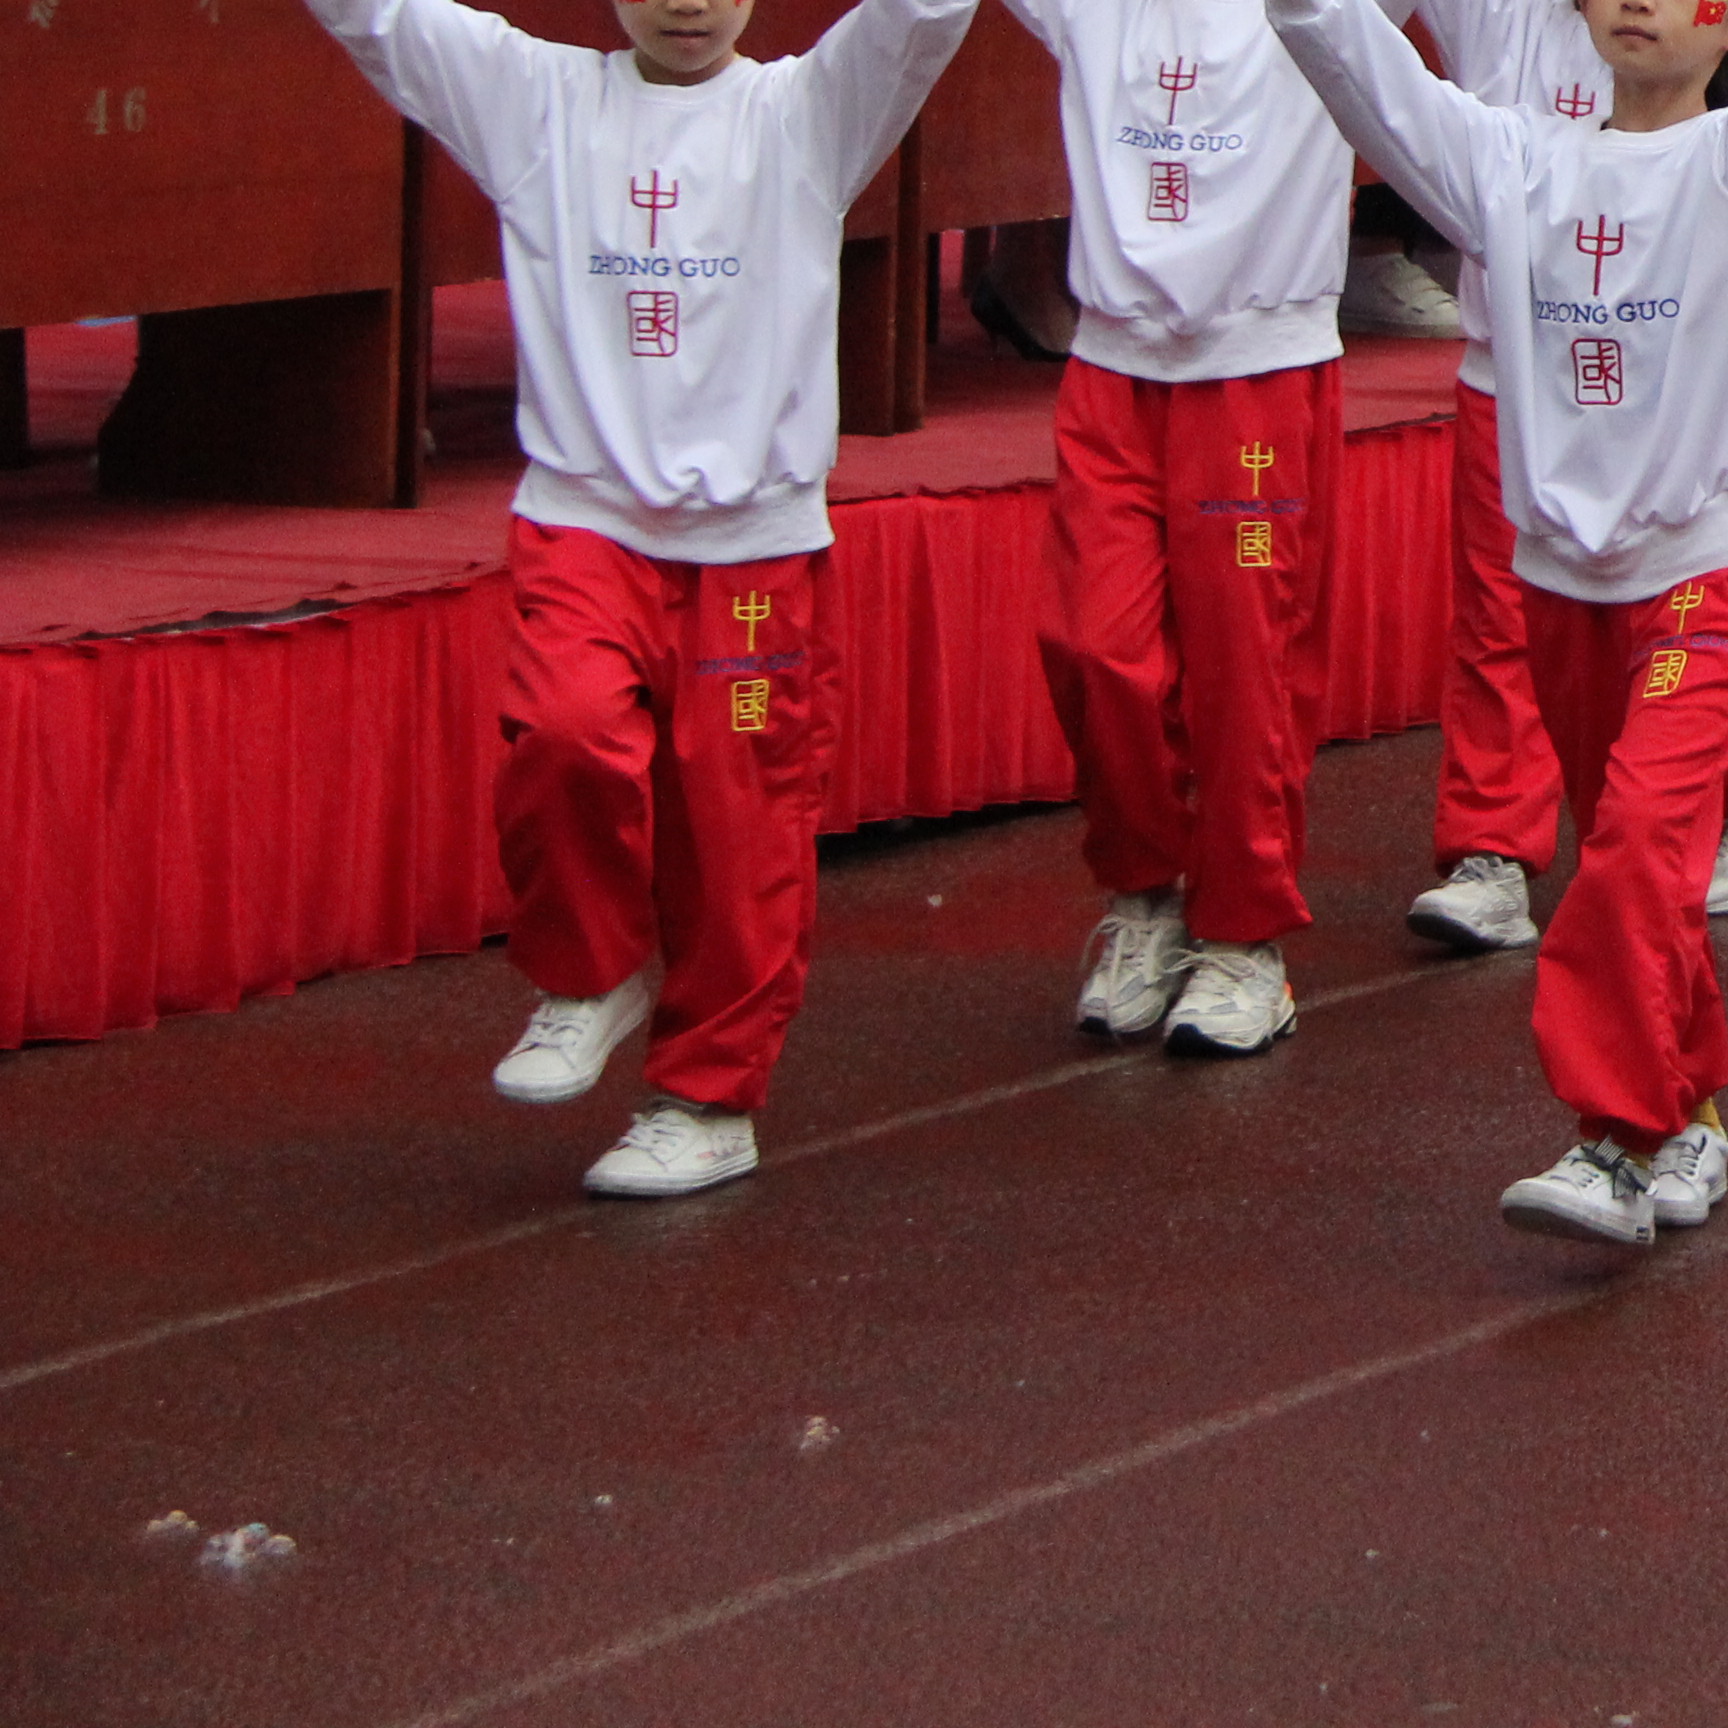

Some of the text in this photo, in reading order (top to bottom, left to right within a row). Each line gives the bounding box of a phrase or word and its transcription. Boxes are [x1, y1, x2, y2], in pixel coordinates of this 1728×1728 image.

[1190, 134, 1243, 152] GUO
[678, 257, 741, 277] GUO
[1537, 296, 1680, 325] ZHONG GUO
